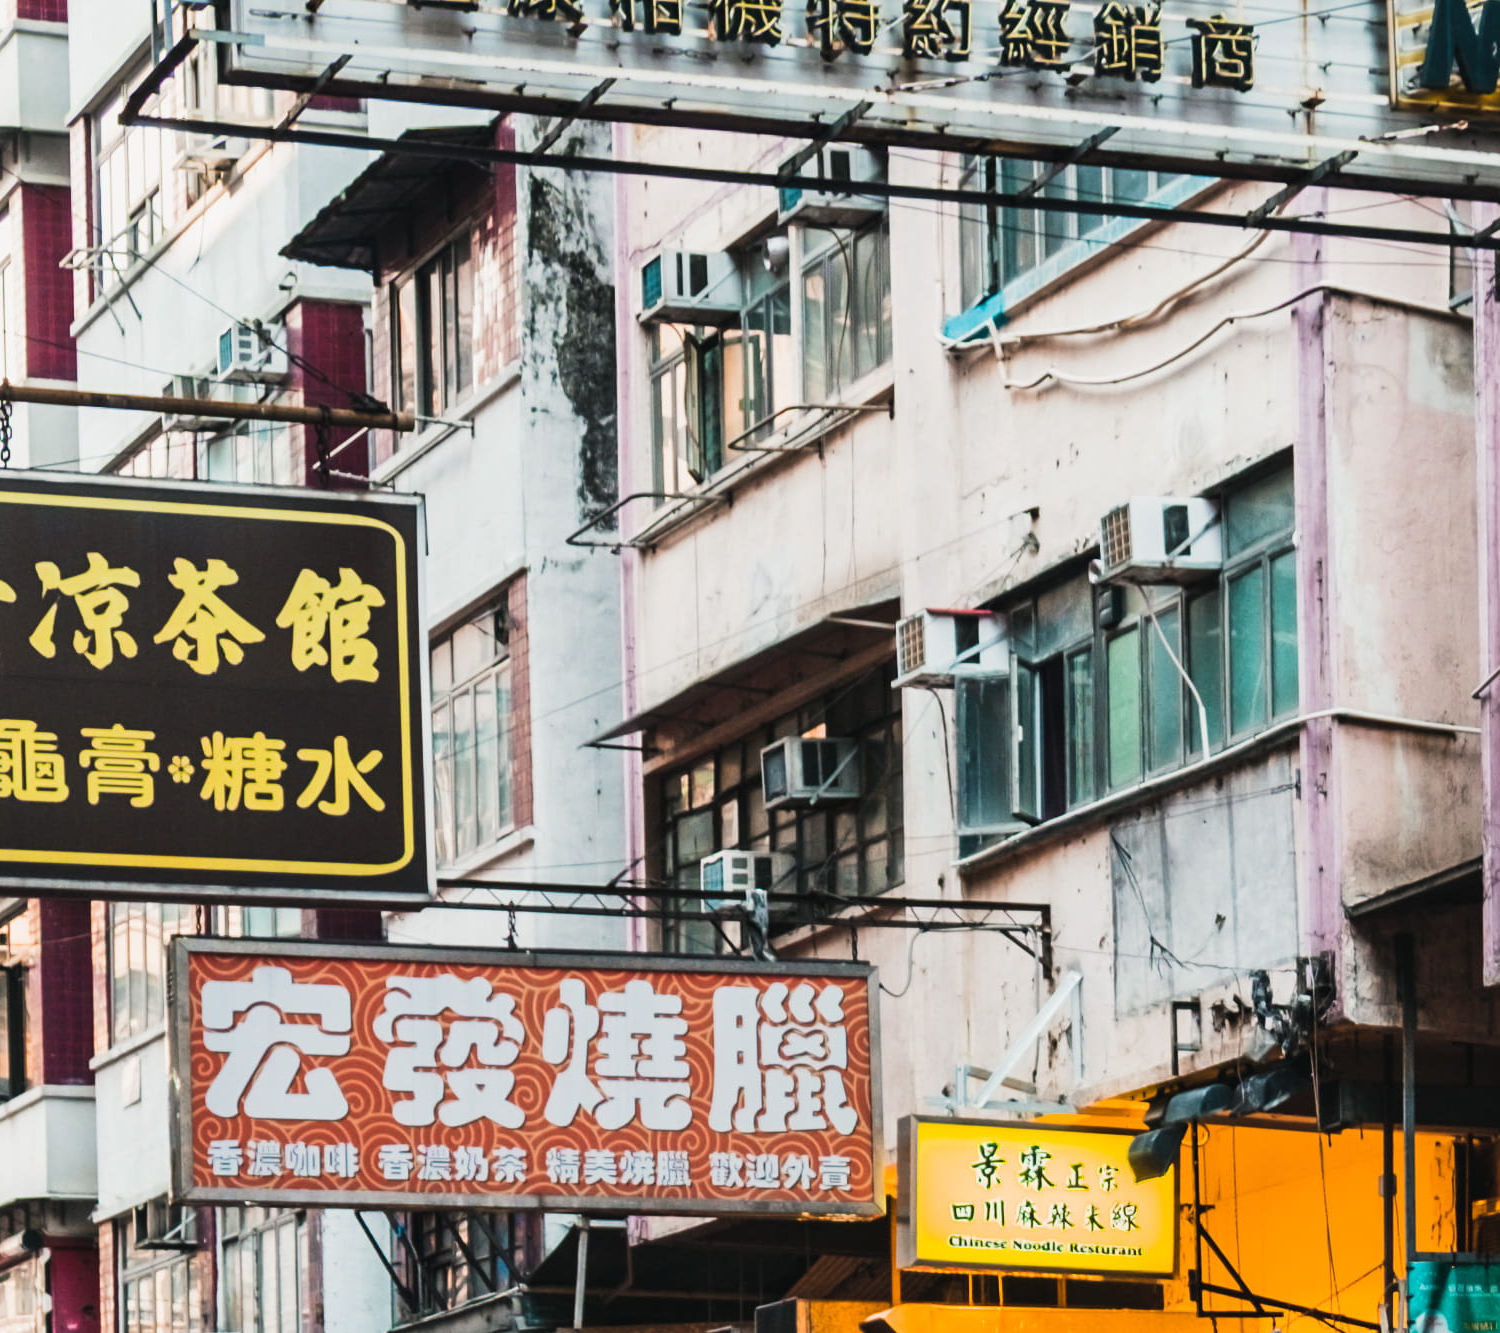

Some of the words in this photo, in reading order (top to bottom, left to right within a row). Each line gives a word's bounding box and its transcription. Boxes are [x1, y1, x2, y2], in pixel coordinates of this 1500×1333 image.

[199, 728, 386, 817] 糖水
[207, 1139, 360, 1179] 香濃咖啡
[378, 1143, 528, 1184] 香濃奶茶
[710, 1153, 851, 1191] 歡迎外賣
[948, 1235, 1008, 1250] Chinese
[1012, 1240, 1065, 1254] Noodle
[1069, 1242, 1143, 1257] Resturant
